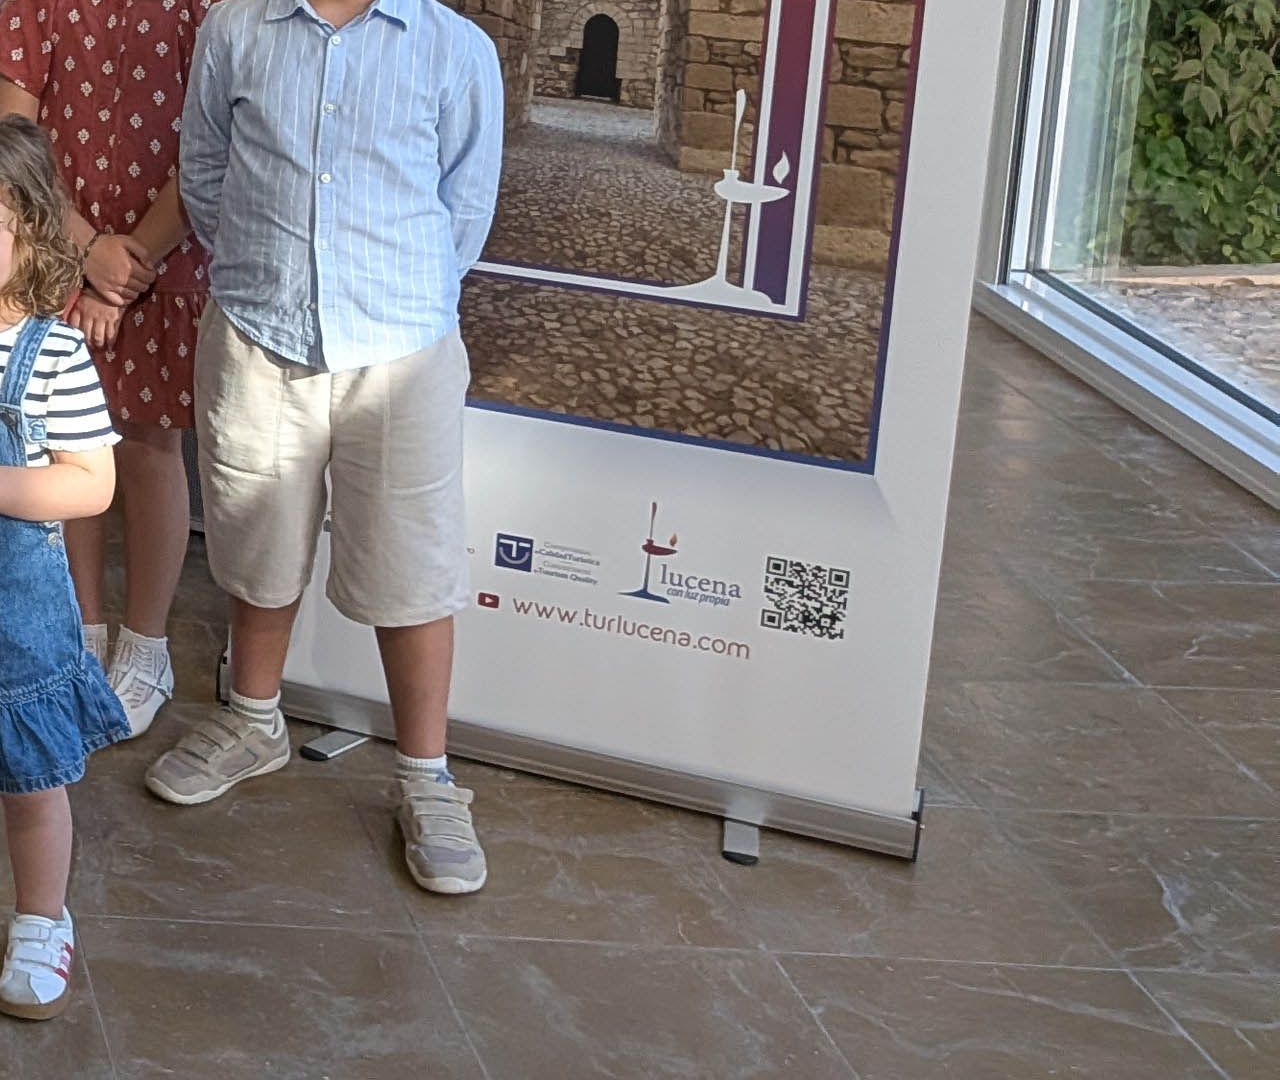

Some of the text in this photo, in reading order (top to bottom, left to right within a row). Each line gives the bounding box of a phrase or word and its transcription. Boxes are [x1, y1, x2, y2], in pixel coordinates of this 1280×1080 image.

[660, 563, 742, 598] lucena
[666, 587, 730, 607] con luz propia
[512, 597, 750, 660] www.turlucena.com
